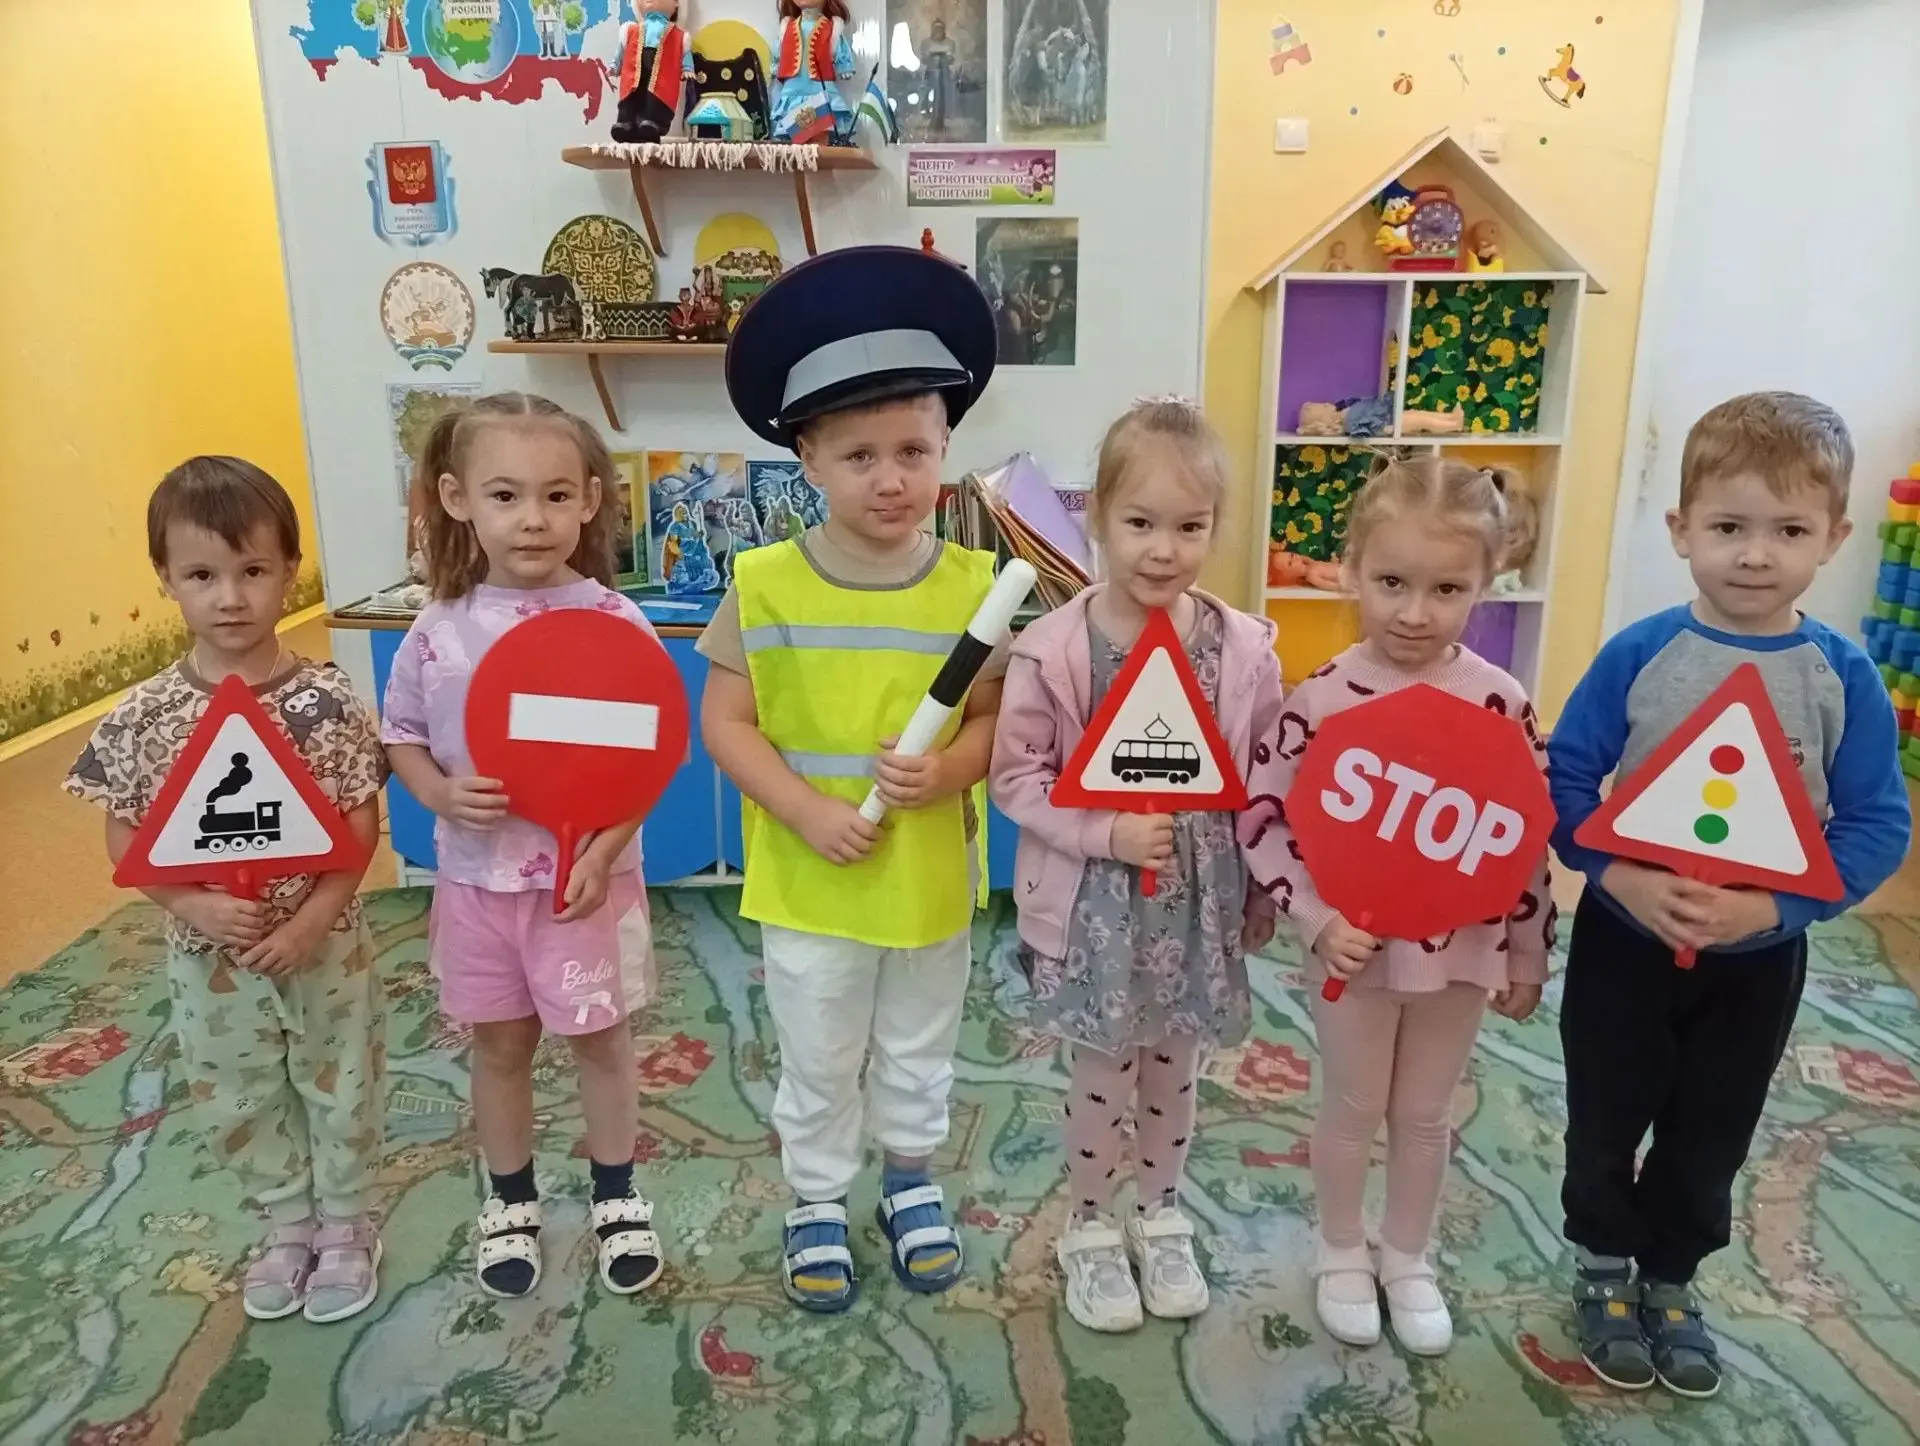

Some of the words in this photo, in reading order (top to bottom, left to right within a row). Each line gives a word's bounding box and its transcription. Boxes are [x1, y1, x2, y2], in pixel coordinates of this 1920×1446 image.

[451, 5, 492, 14] РОССИЯ
[917, 160, 954, 170] ЦЕНТР
[917, 175, 1023, 184] ПАТРИОТИЧЕСКОГО
[917, 188, 989, 198] ВОСПИТАНИЯ
[1320, 747, 1525, 877] STOP
[561, 957, 616, 990] Barbie
